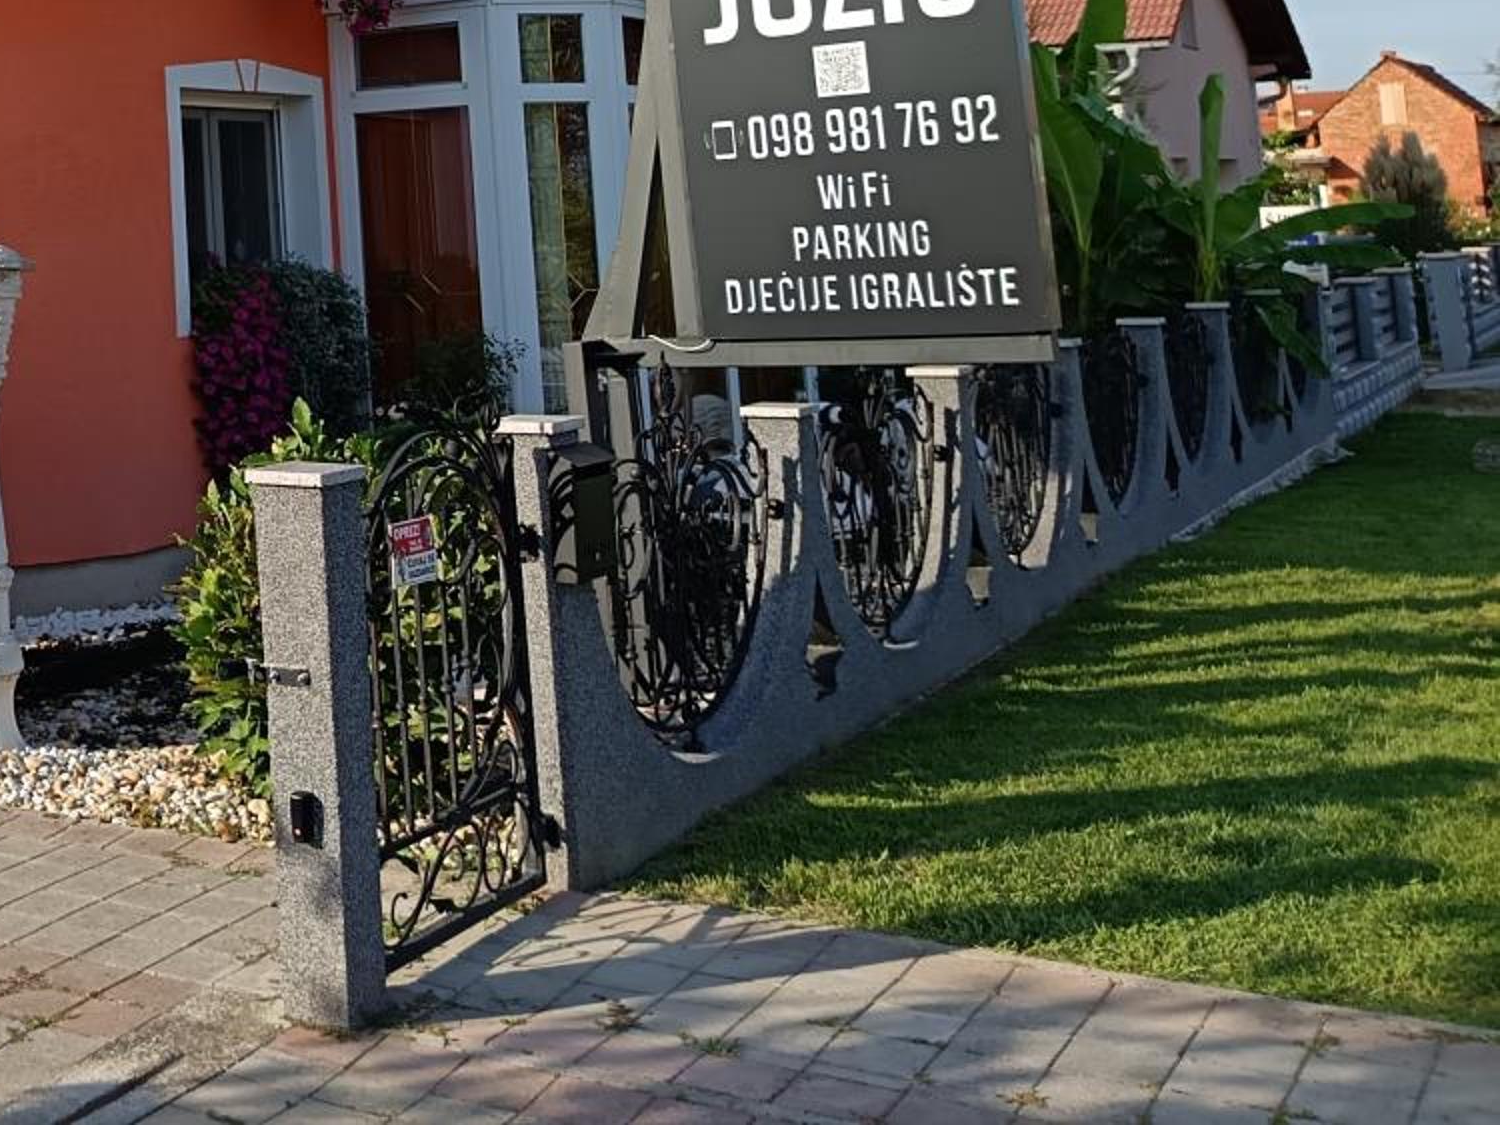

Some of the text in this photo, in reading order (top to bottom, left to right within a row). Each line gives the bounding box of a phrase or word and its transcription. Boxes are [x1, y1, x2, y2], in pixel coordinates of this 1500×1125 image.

[747, 94, 999, 160] 098 981 76 92
[793, 220, 930, 262] PARKING
[725, 263, 1020, 314] DJEČIJE IGRALIŠTE
